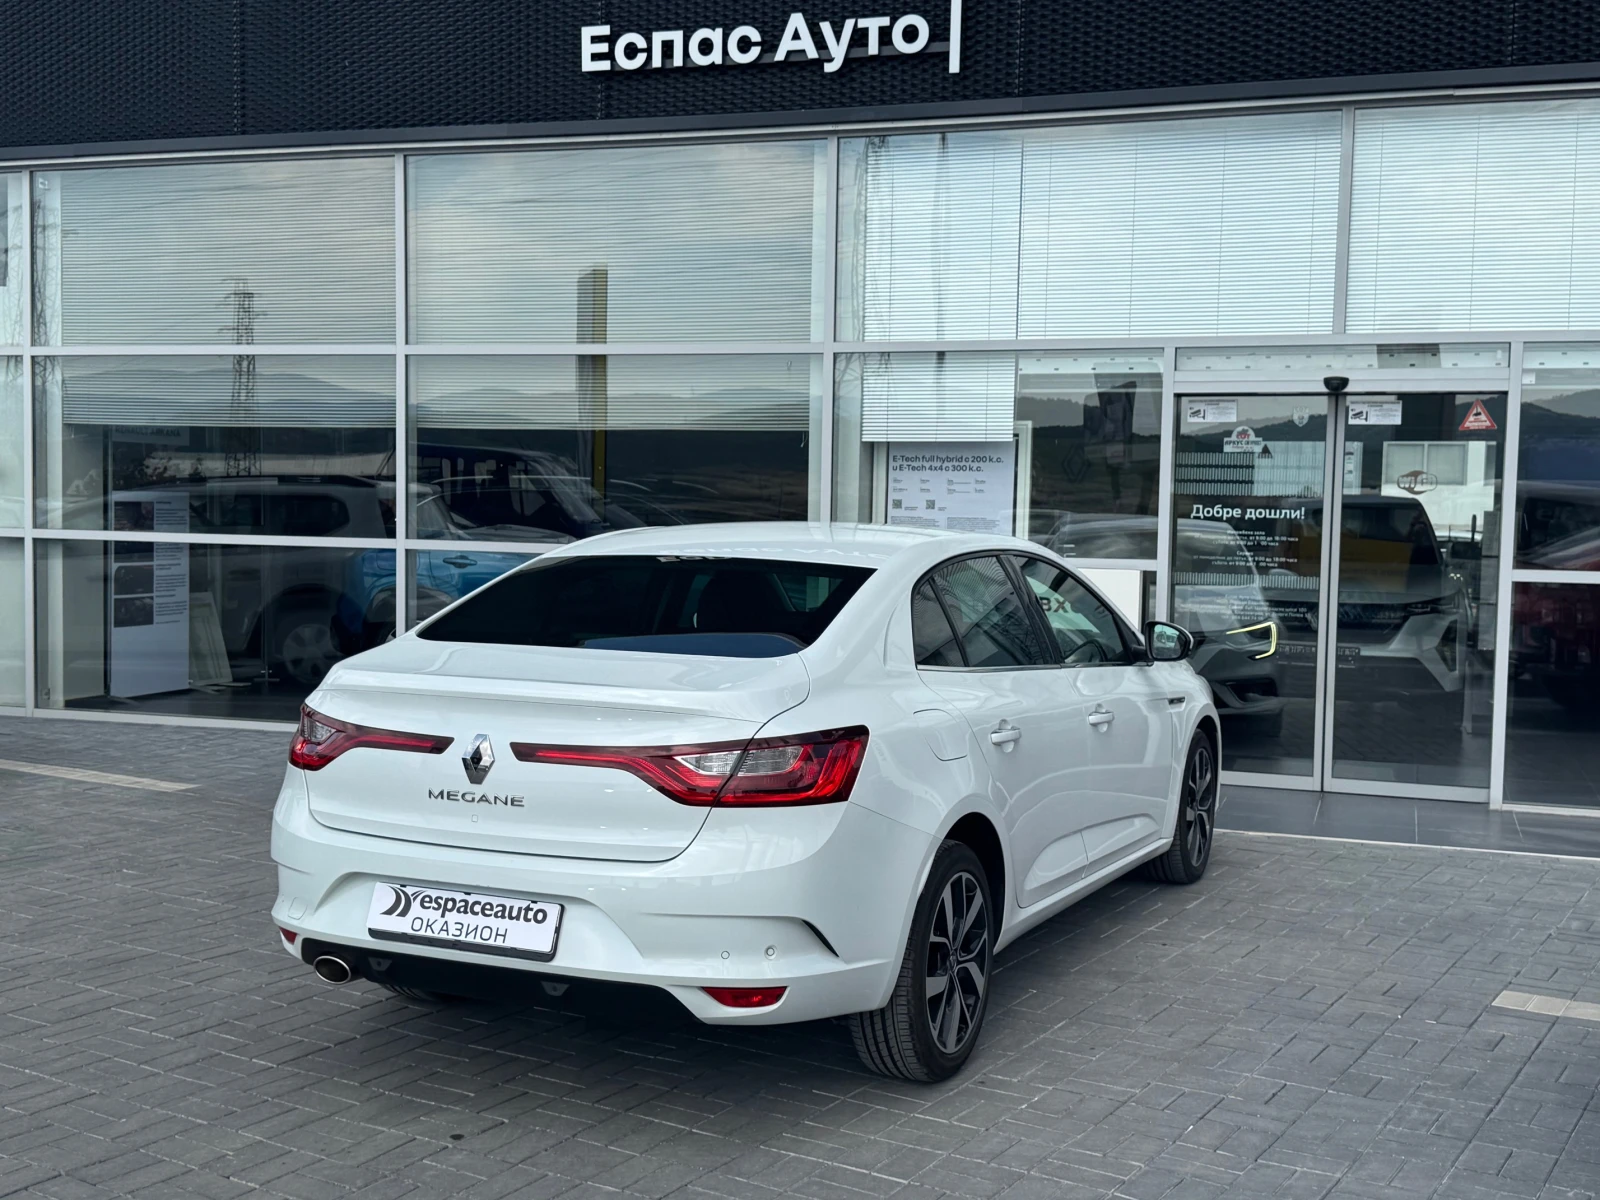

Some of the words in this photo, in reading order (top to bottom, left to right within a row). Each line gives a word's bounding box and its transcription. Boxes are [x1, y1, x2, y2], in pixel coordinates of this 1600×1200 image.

[580, 24, 762, 72] Еспас
[773, 12, 930, 73] Ауто
[892, 455, 920, 463] E-Tech
[921, 455, 935, 463] full
[935, 455, 963, 464] hybrid
[898, 464, 926, 472] E-Tech
[950, 464, 967, 472] 300
[1190, 504, 1242, 520] Добре
[1245, 506, 1306, 520] дошли!
[428, 787, 525, 808] MEGANE
[419, 893, 548, 925] espaceauto
[410, 916, 509, 944] ОКАЗИОН
